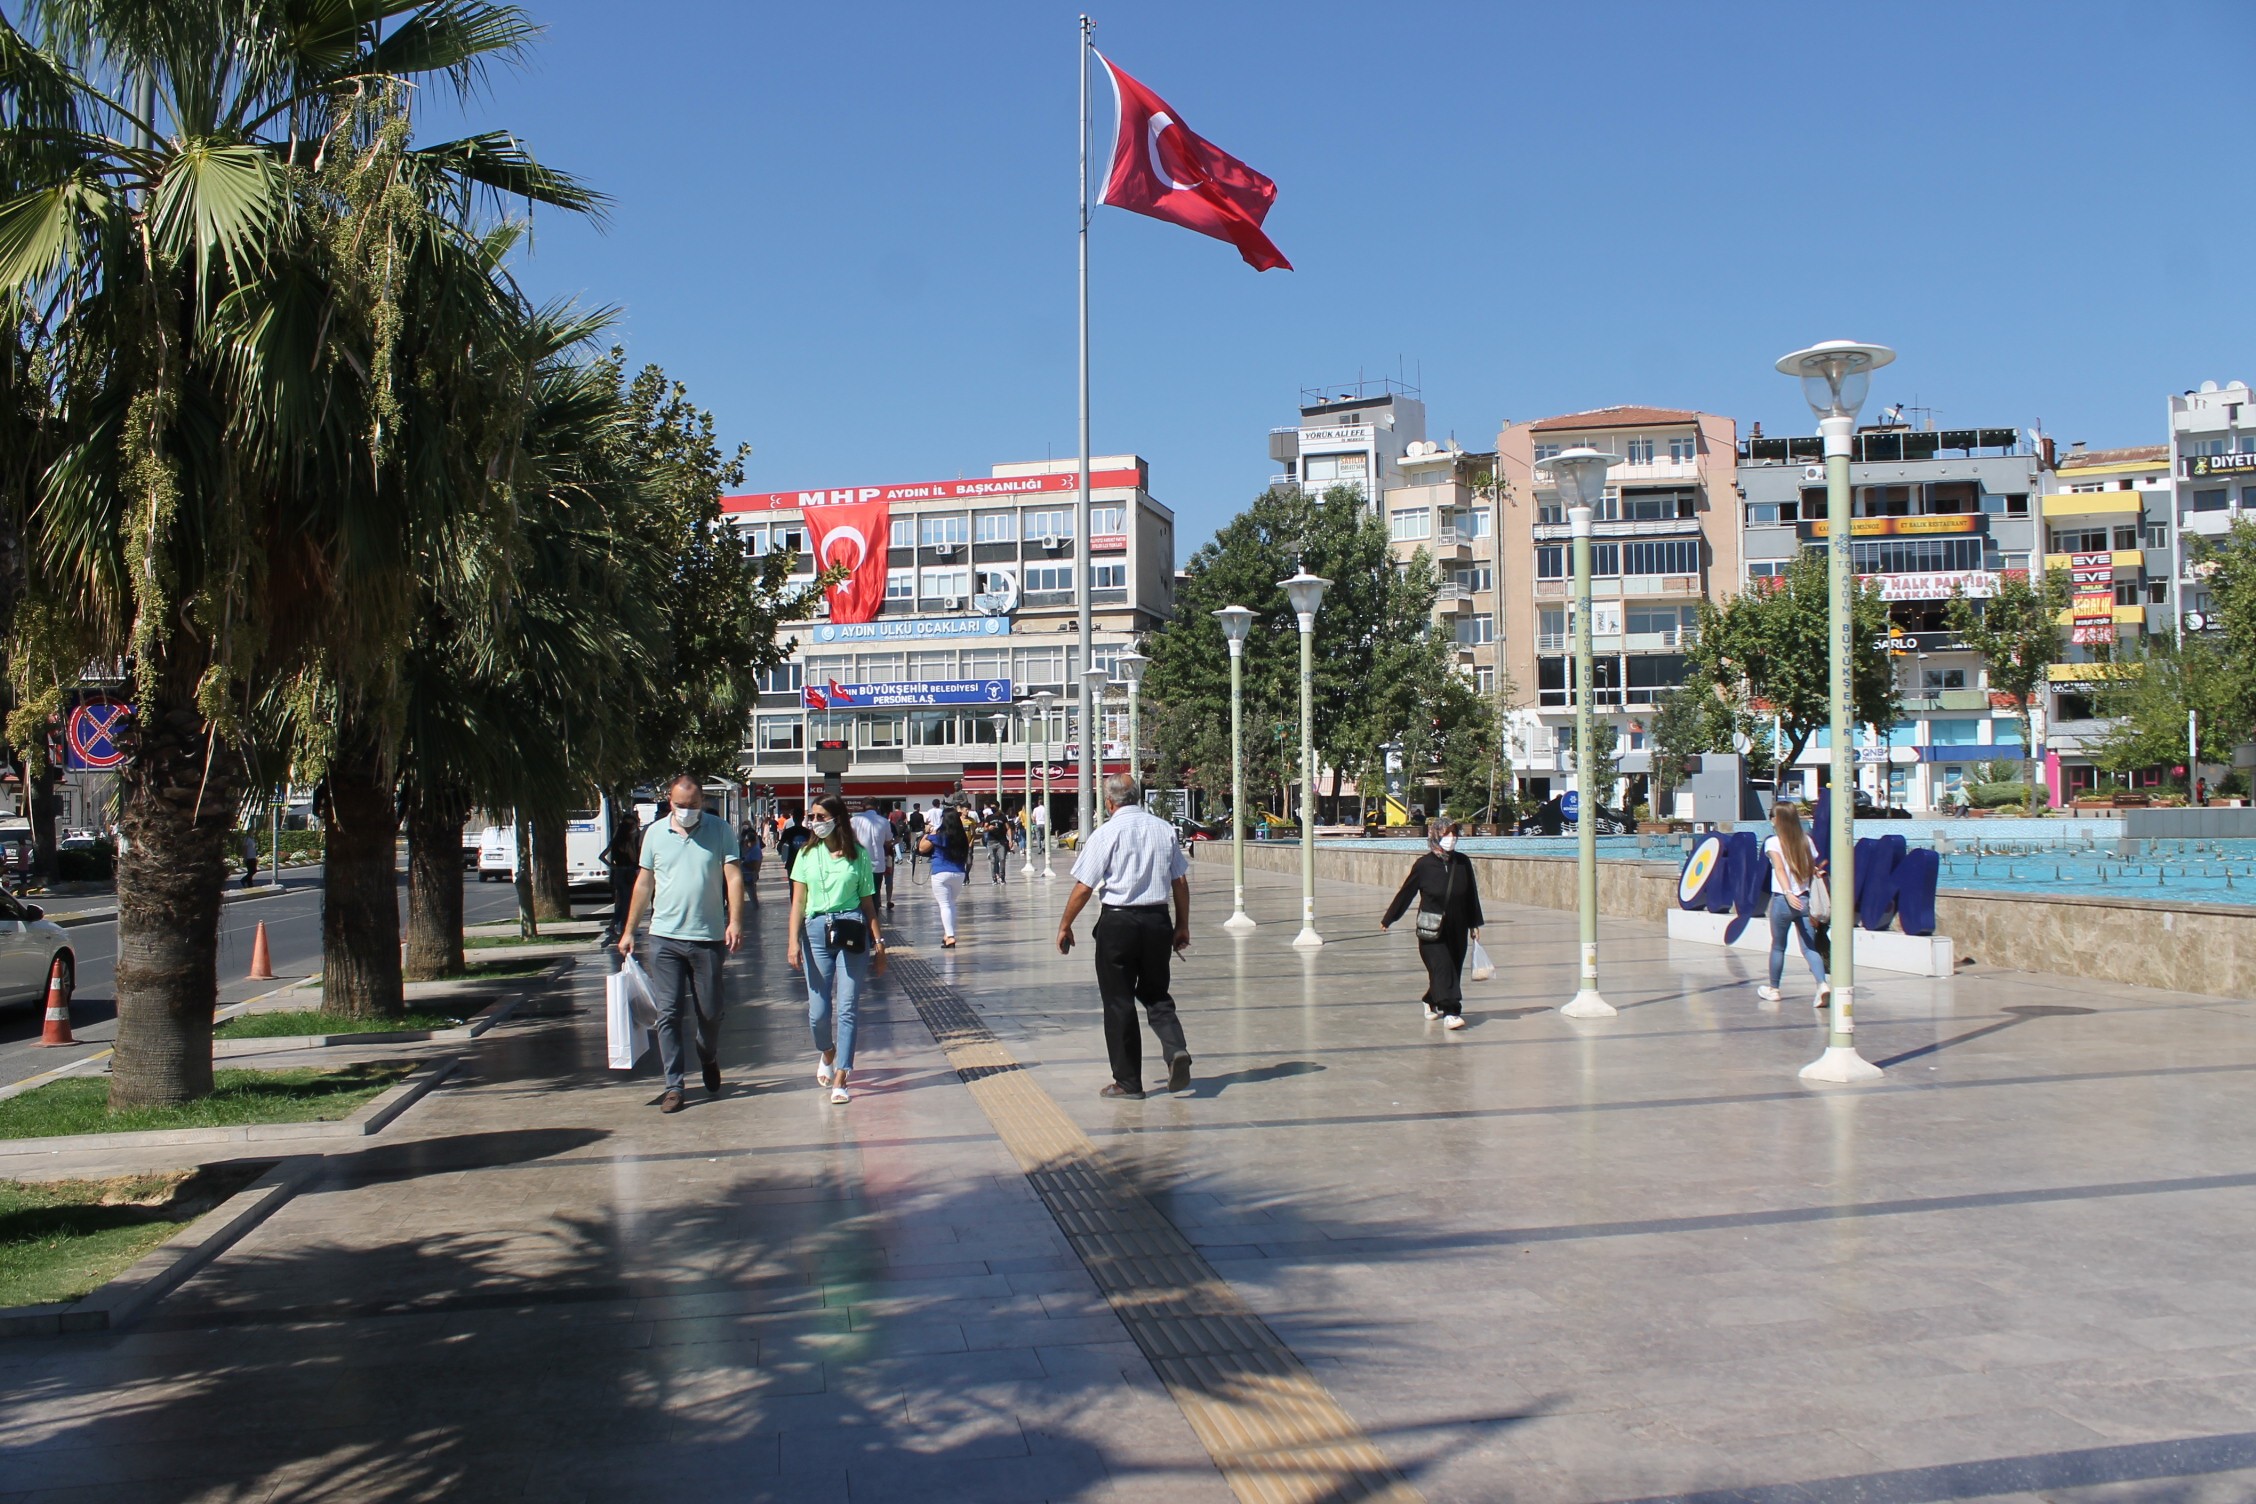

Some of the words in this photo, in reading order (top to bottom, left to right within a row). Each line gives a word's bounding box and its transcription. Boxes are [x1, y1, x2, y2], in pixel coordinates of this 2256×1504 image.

[1351, 429, 1365, 437] EFE
[798, 488, 881, 506] MHP
[887, 487, 929, 499] AYDIN
[933, 484, 946, 496] İL
[956, 479, 1042, 496] BAŞKANLIĞI
[2072, 554, 2111, 566] EVE
[2073, 571, 2111, 582] EVE
[1891, 577, 1929, 590] HALK
[2073, 596, 2112, 616] KİRALIK
[841, 625, 875, 638] AYDIN
[880, 622, 912, 637] ÜLKÜ
[917, 620, 980, 634] OCAKLARI
[859, 682, 928, 696] BÜYÜKŞEHİR
[930, 684, 979, 693] BELEDİYESİ
[873, 695, 918, 705] PERSONEL
[1862, 747, 1884, 757] QNB
